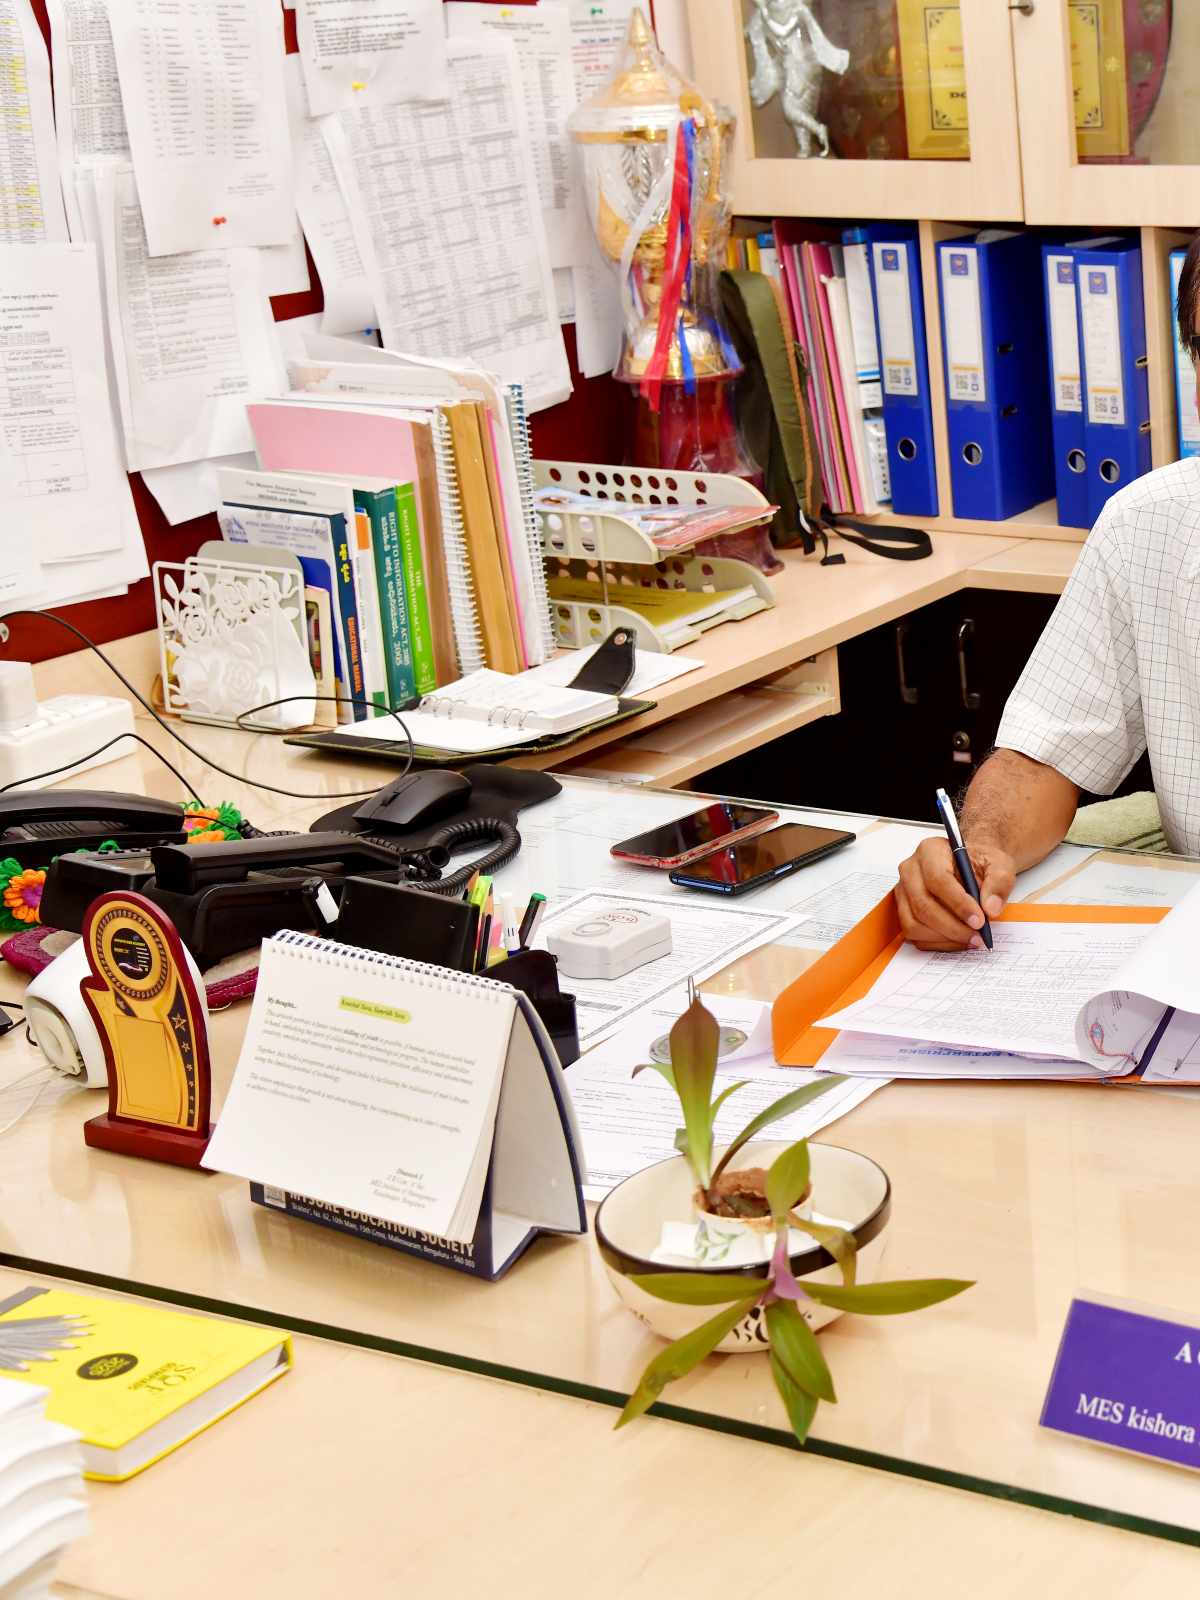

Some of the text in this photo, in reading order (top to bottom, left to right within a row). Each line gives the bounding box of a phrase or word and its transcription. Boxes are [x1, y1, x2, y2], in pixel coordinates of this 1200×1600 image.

[388, 511, 398, 541] RIGHT
[392, 543, 400, 558] TO
[393, 558, 406, 625] INFORMATION
[420, 1230, 475, 1258] SOCIETY
[1174, 1341, 1193, 1364] A
[1076, 1393, 1125, 1424] MES
[1127, 1405, 1196, 1443] kishora
